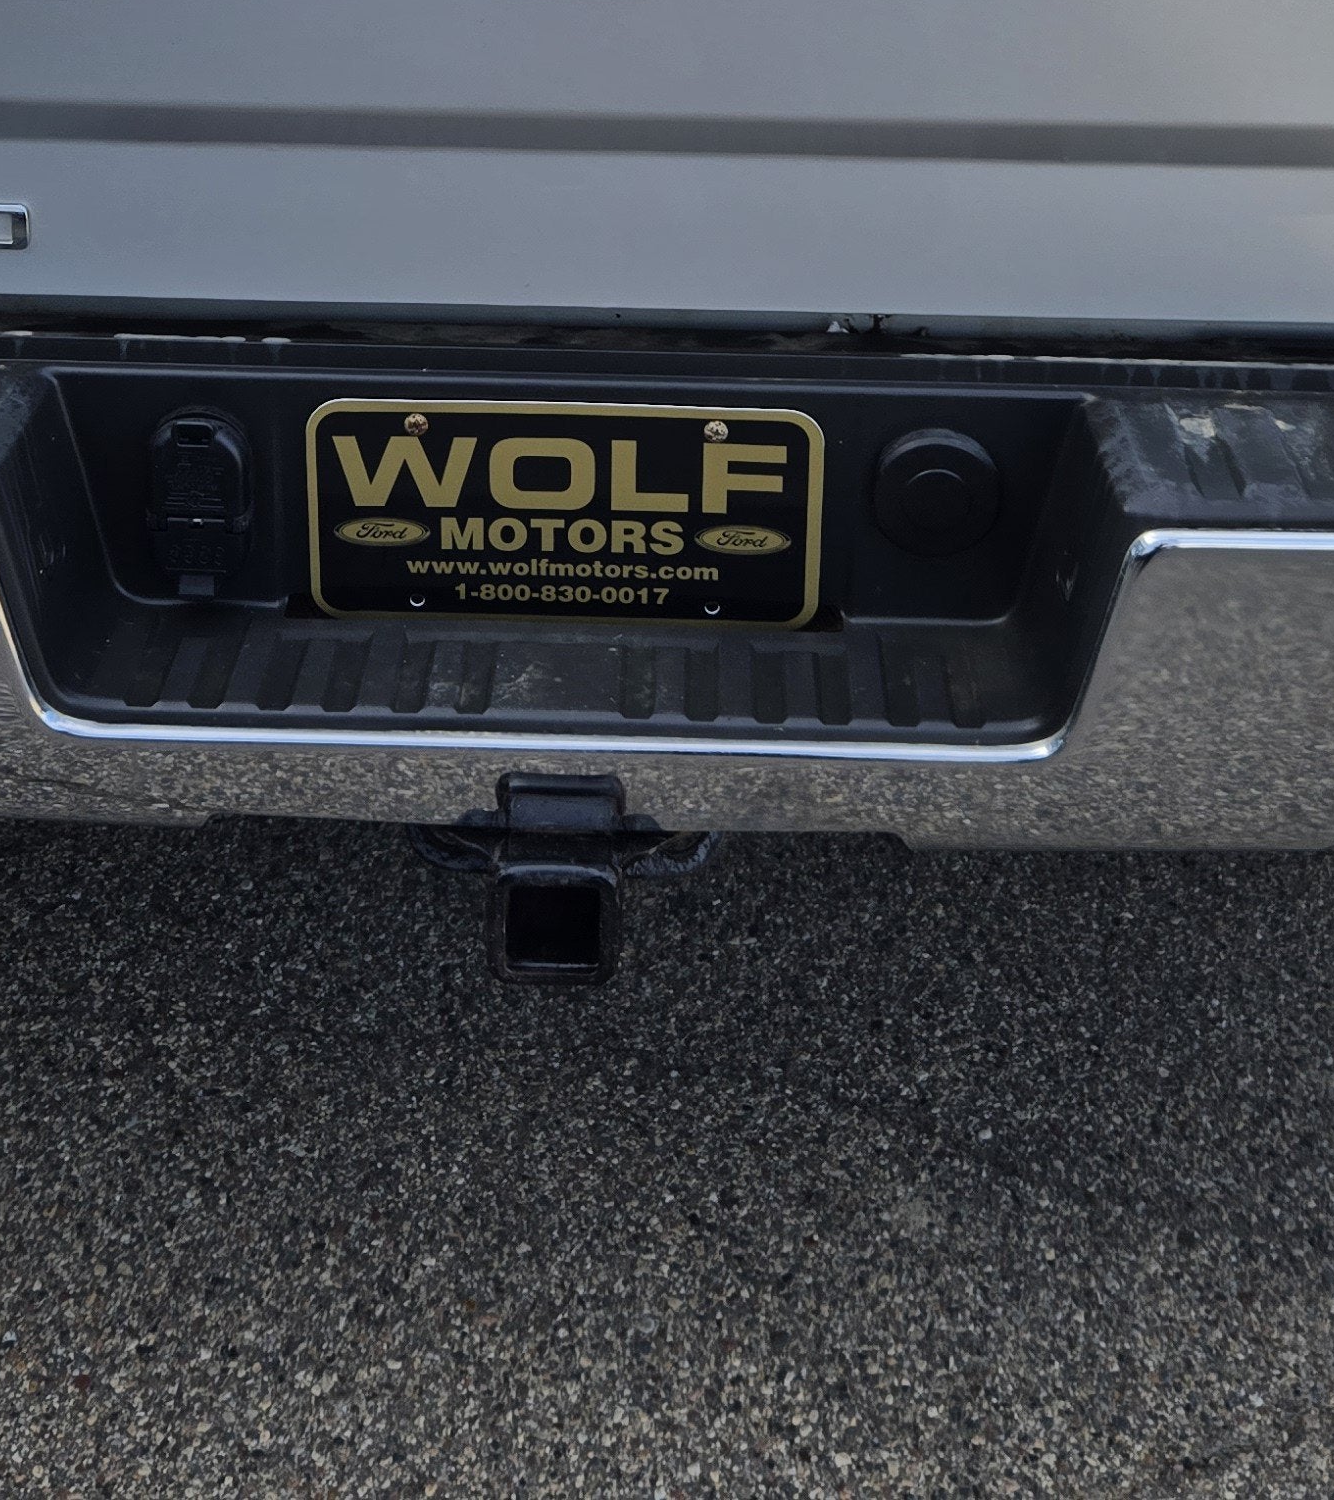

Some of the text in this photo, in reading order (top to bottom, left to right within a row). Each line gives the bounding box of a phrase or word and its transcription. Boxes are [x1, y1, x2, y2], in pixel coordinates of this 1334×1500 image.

[332, 435, 788, 514] WOLF
[355, 522, 408, 539] Ford
[440, 516, 685, 555] MOTORS
[716, 531, 769, 548] Ford
[406, 558, 720, 581] www.wolfmotors.com
[455, 582, 670, 605] 1-800-830-0017
